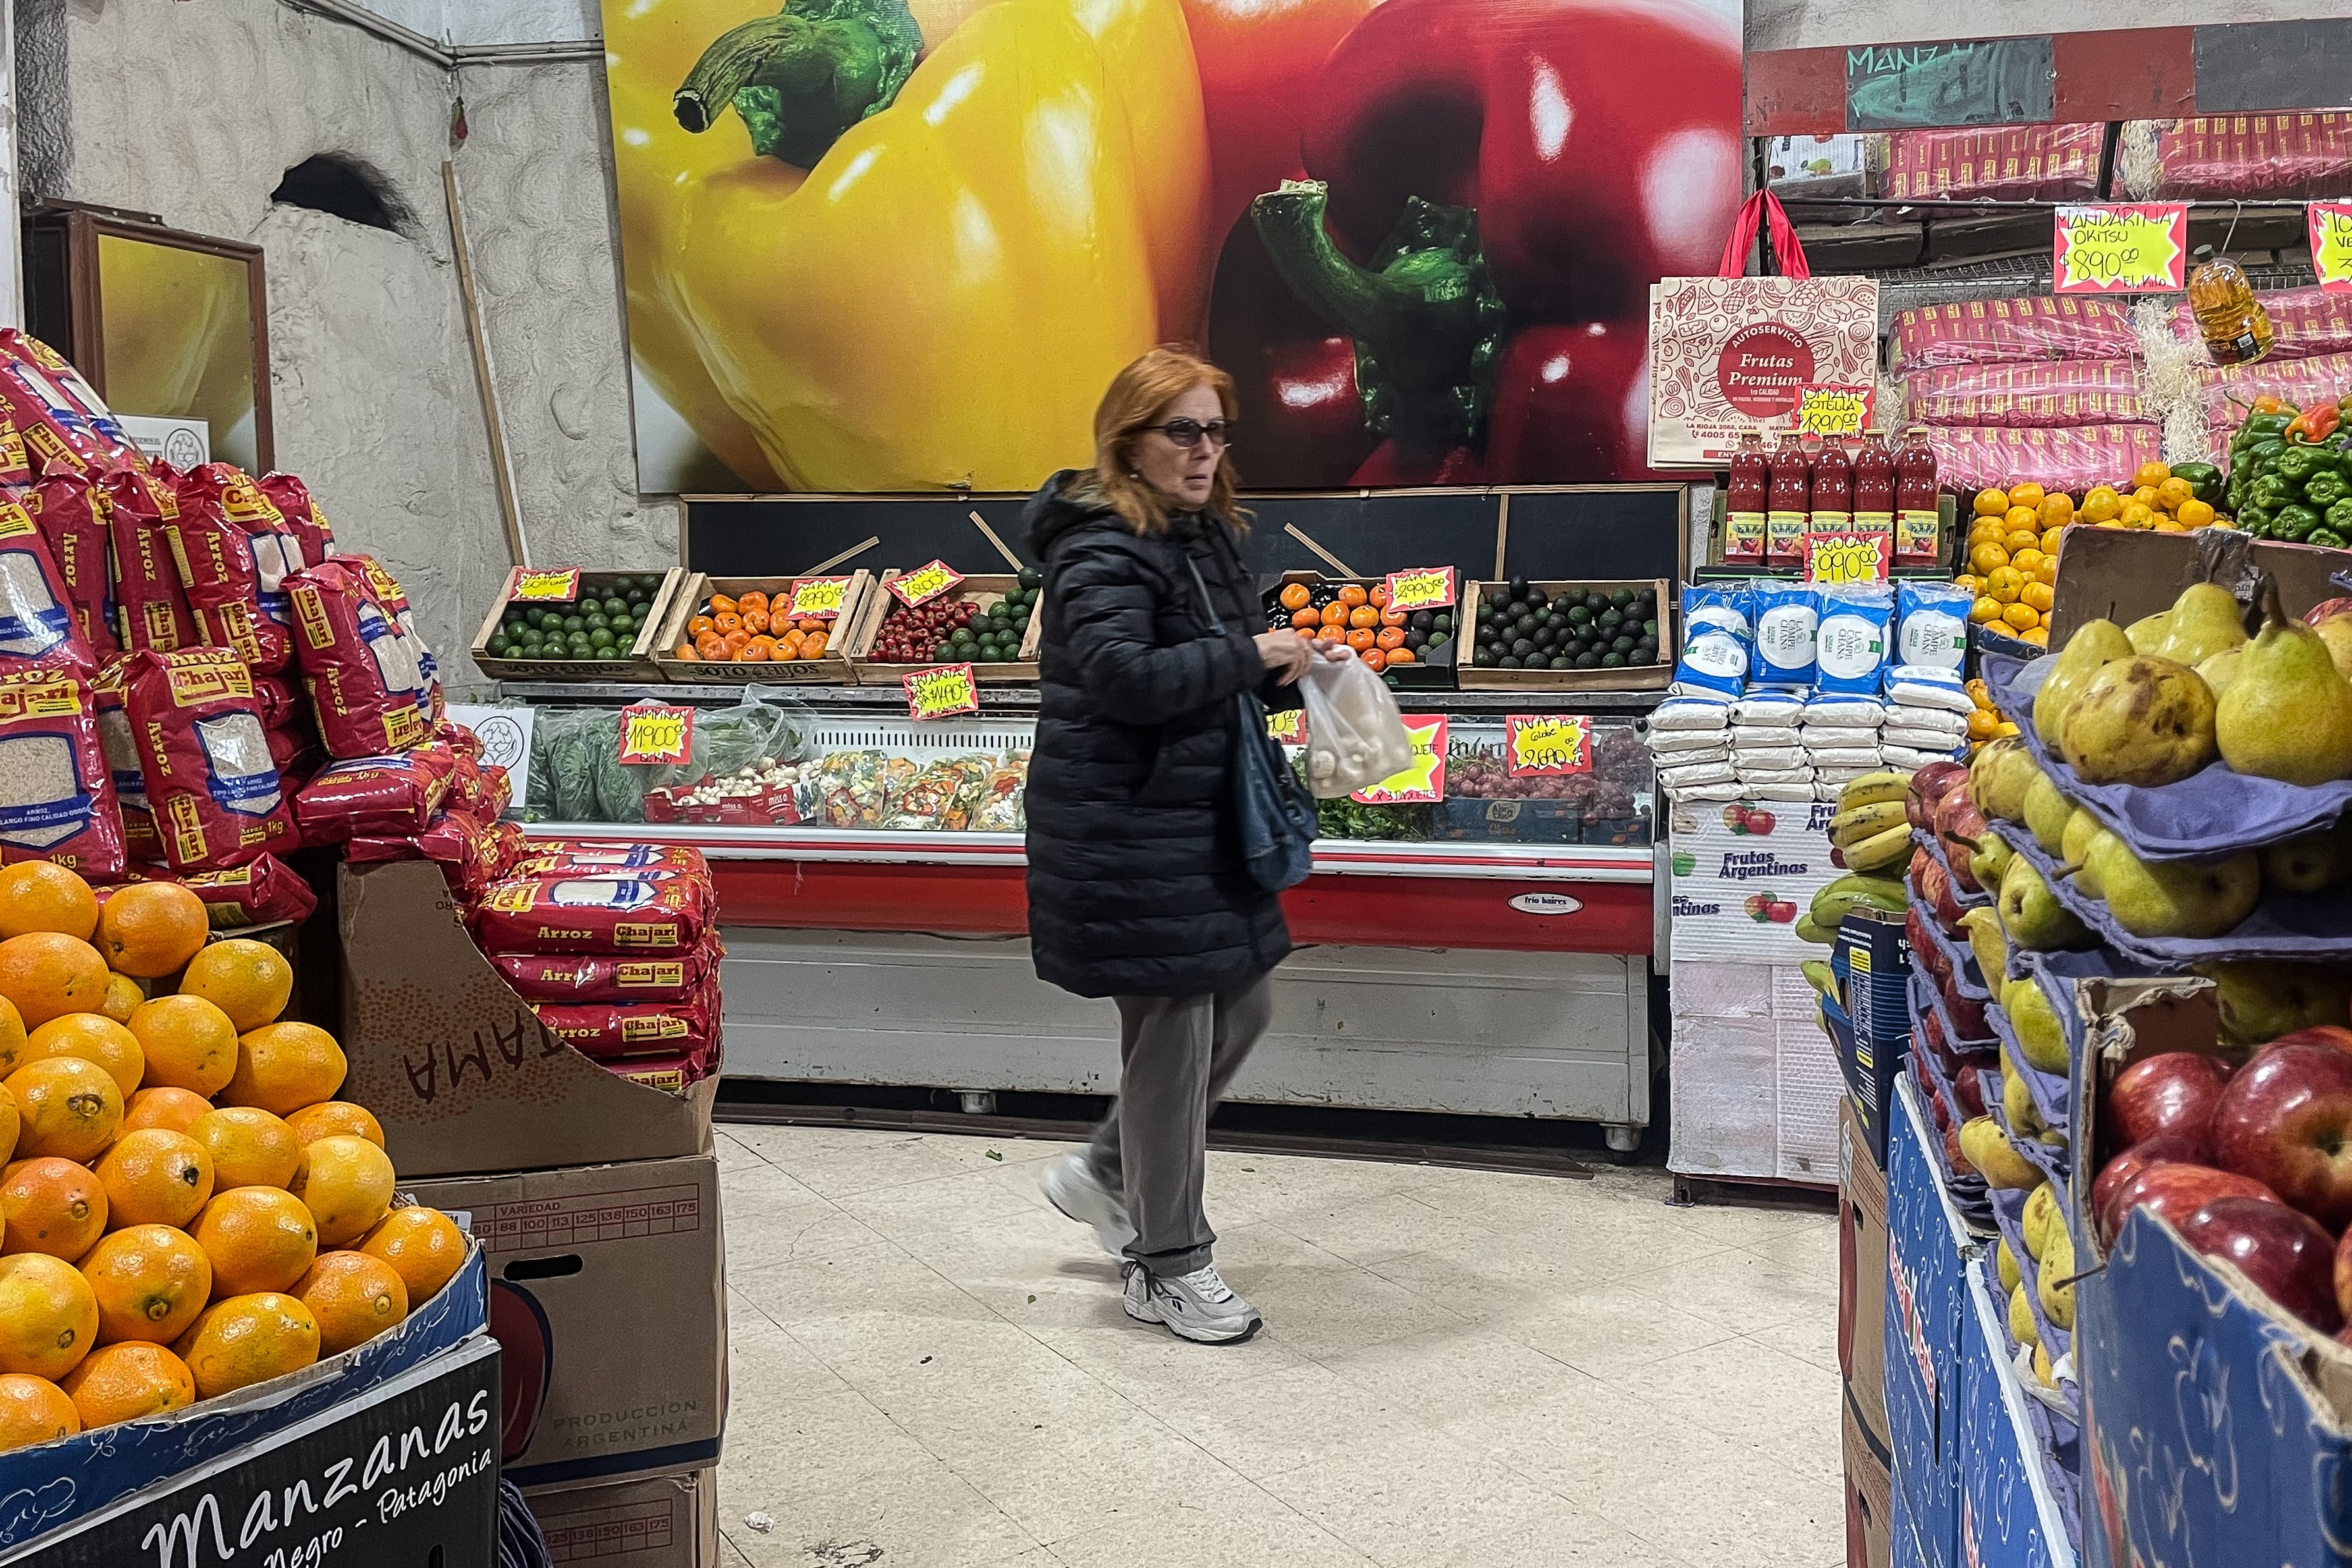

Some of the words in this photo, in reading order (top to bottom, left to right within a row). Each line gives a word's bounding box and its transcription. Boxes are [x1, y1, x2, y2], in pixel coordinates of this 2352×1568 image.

[1731, 325, 1803, 349] AUTOSERVICIO
[1739, 352, 1793, 367] Frutas
[1728, 372, 1803, 387] Premium
[1803, 400, 1855, 411] BOTELLA
[63, 532, 78, 587] Arroz
[137, 527, 156, 581] Arroz
[206, 531, 229, 583] Arroz
[298, 588, 333, 645] Chajarí
[1796, 621, 1804, 632] LA
[1940, 626, 1948, 639] LA
[1837, 629, 1846, 660] CHANA
[1845, 630, 1854, 660] CAMPE
[1854, 631, 1862, 643] LA
[1921, 624, 1932, 655] CHANA
[1930, 625, 1940, 657] CAMPE
[169, 651, 238, 666] Arroz
[174, 664, 248, 699] Chajarí
[0, 684, 70, 718] ajarí
[327, 667, 348, 717] Arroz
[147, 721, 173, 778] Arroz
[1411, 743, 1437, 756] QUETE
[0, 817, 23, 826] LARGO
[41, 812, 68, 821] CALIDAD
[1811, 804, 1837, 817] Fru
[267, 820, 283, 834] 1kg
[49, 853, 77, 869] 1kg
[1723, 851, 1775, 865] Frutas
[1718, 861, 1808, 880] Argentinas
[1672, 899, 1721, 916] ntinas
[537, 926, 593, 940] Arroz
[615, 925, 676, 944] Chajarí
[619, 965, 680, 983] Chajarí
[627, 1071, 680, 1088] hajarí
[499, 1202, 561, 1217] VARIEDAD
[500, 1221, 517, 1233] 88
[522, 1219, 545, 1230] 100
[549, 1216, 569, 1227] 113
[574, 1212, 597, 1226] 125
[600, 1211, 622, 1222] 138
[624, 1208, 647, 1220] 150
[651, 1204, 672, 1216] 163
[675, 1202, 696, 1214] 175
[563, 1420, 689, 1447] ARGENTINA
[142, 1388, 491, 1568] Manzanas
[376, 1447, 493, 1525] Patagonia
[572, 1528, 594, 1540] 138
[597, 1526, 620, 1537] 150
[622, 1522, 645, 1534] 163
[647, 1519, 669, 1530] 175
